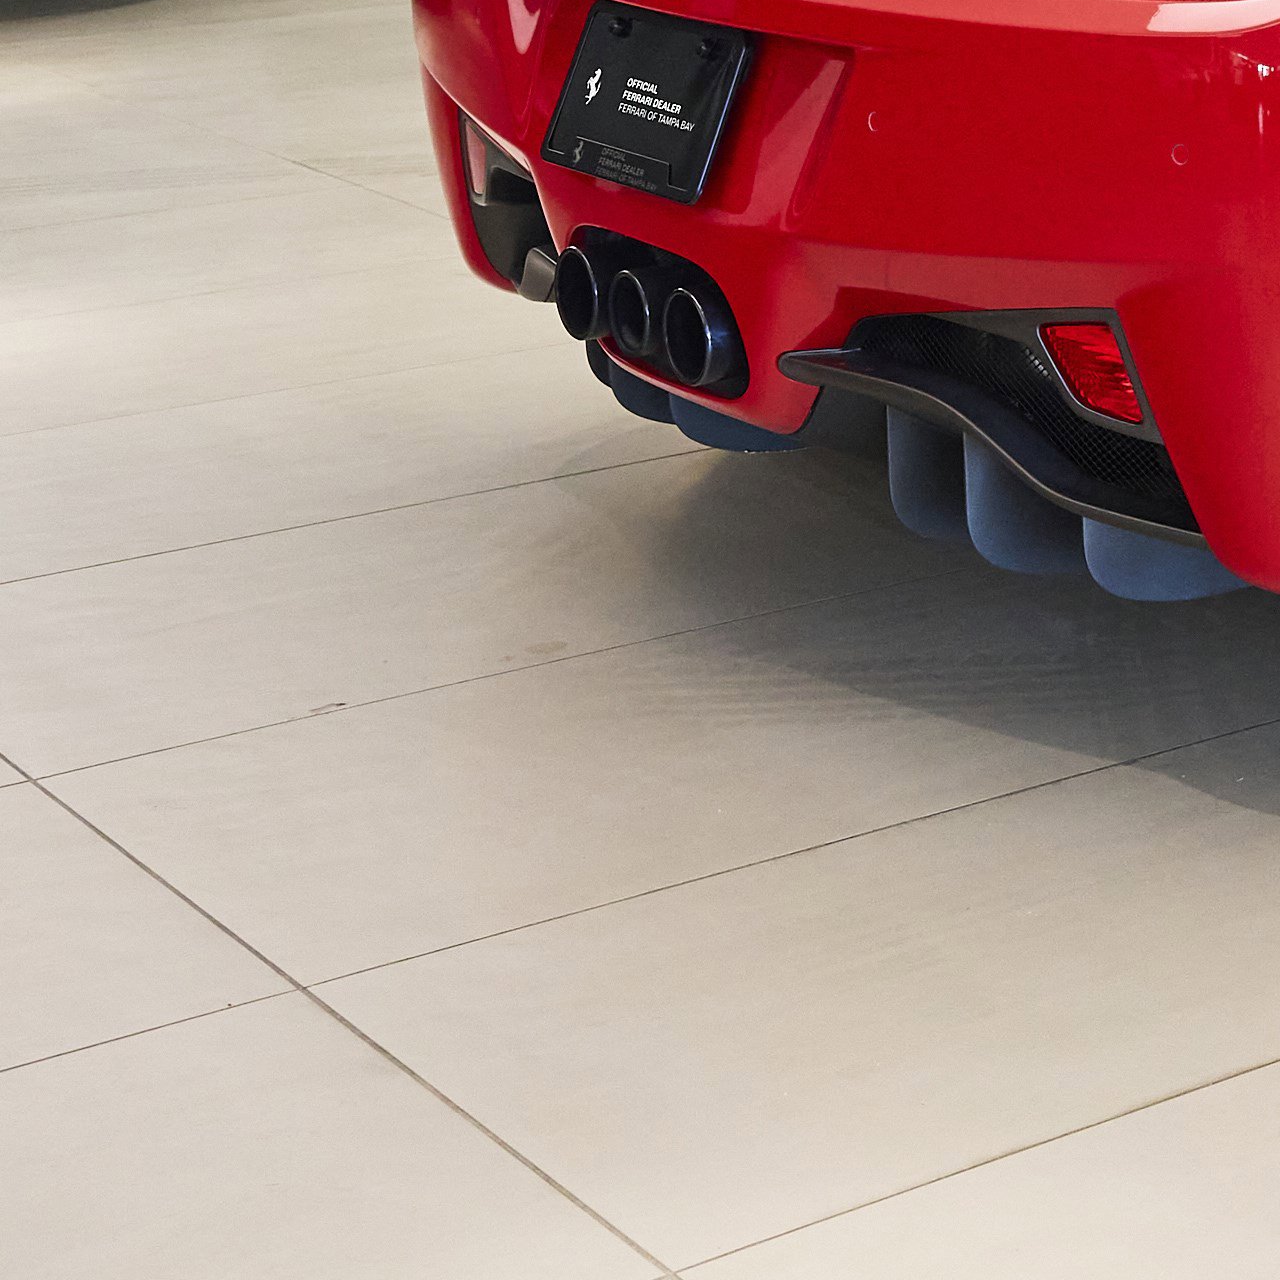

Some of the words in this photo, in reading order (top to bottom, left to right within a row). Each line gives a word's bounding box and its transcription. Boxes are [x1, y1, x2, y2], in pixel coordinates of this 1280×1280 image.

[627, 78, 658, 94] OFFICIAL
[622, 90, 653, 108] FERRARI
[653, 99, 681, 114] DEALER
[618, 102, 647, 118] FERRARI
[647, 111, 658, 121] OF
[658, 113, 680, 128] TAMPA
[680, 120, 695, 132] BAY
[622, 163, 645, 176] DEALER
